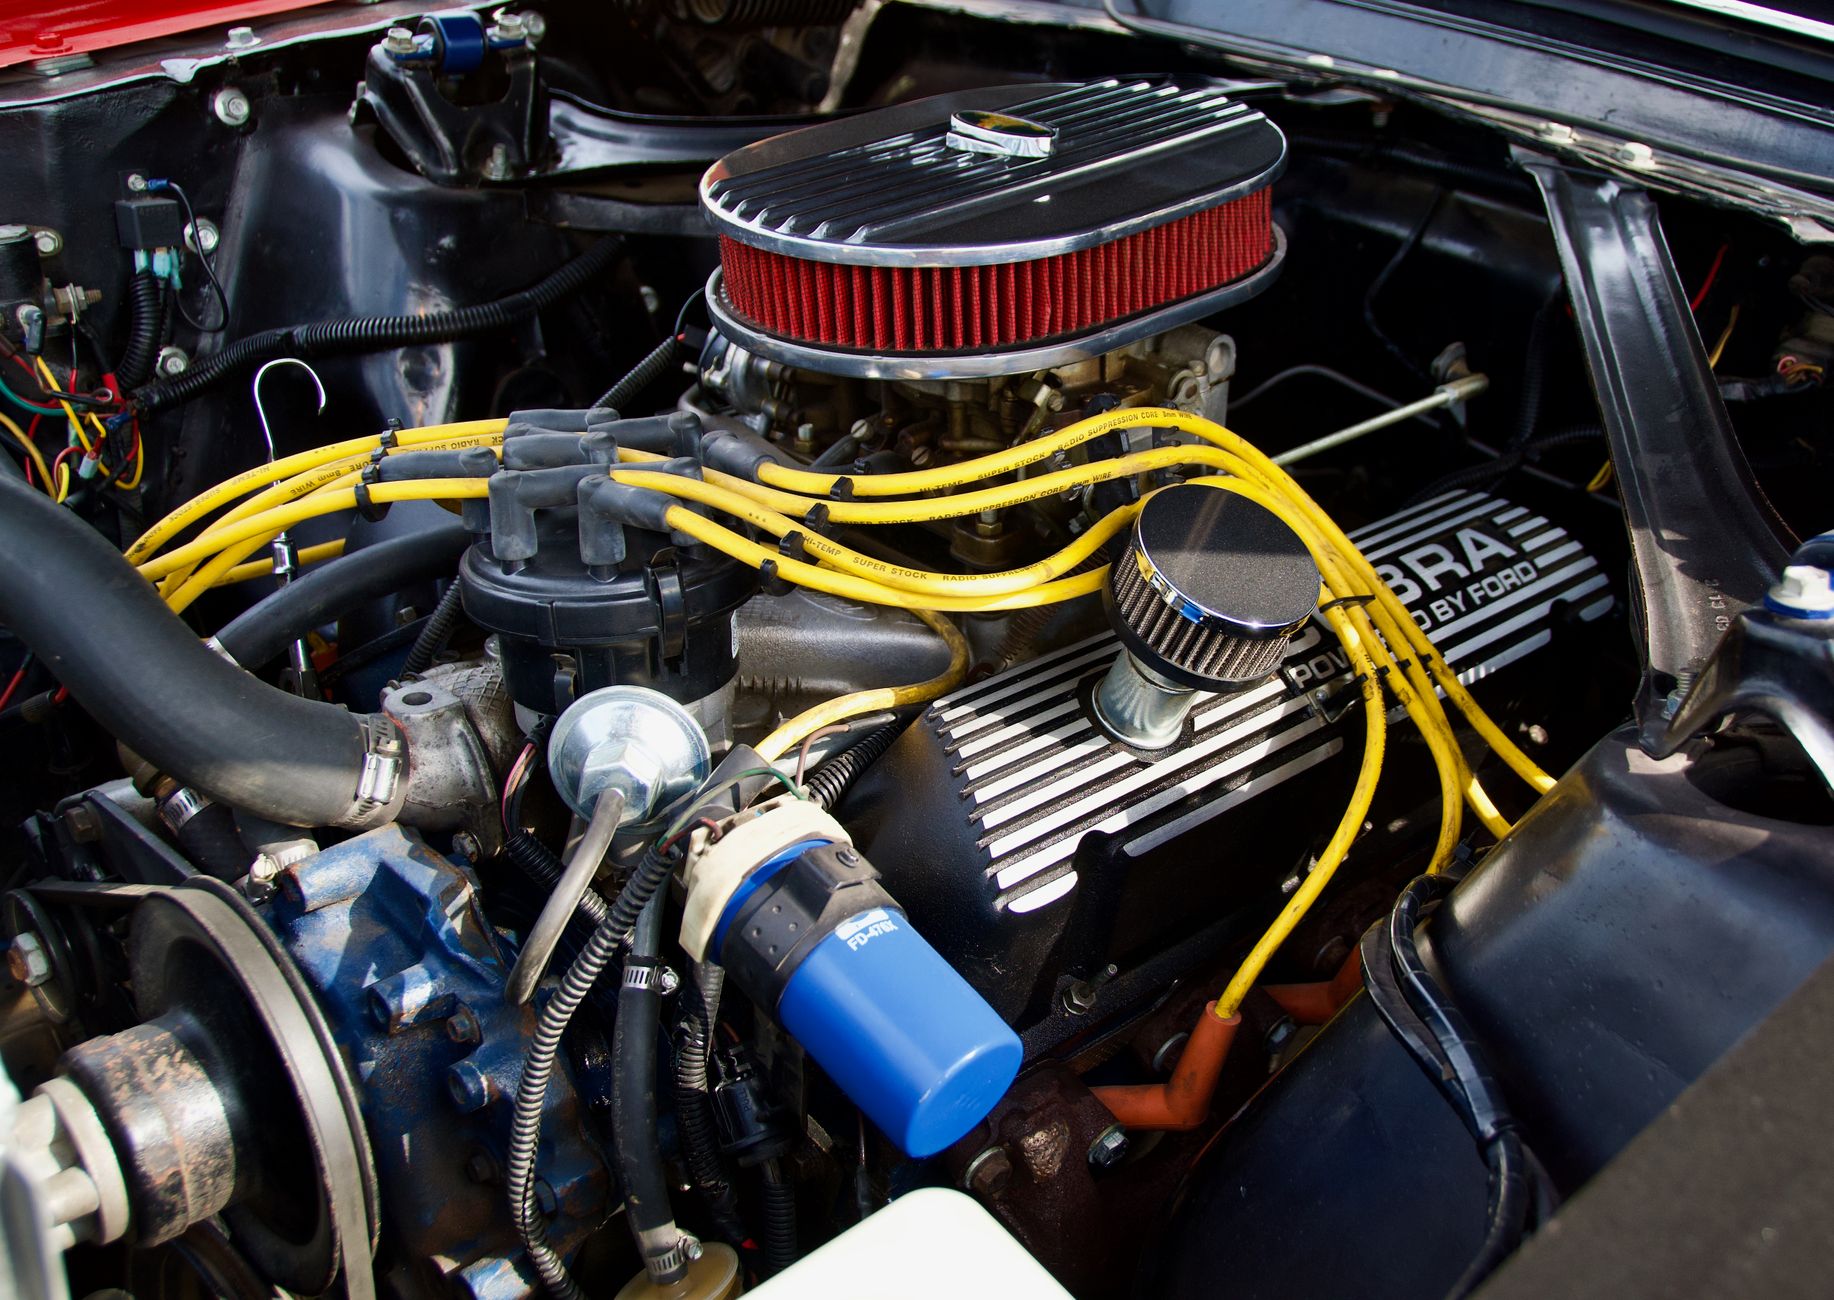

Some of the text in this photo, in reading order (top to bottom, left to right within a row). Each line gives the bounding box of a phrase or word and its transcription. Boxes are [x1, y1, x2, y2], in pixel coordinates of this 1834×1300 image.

[450, 438, 480, 450] RADIO
[977, 465, 1010, 480] SUPER
[1014, 452, 1046, 468] STOCK
[1057, 434, 1085, 450] RADIO
[1088, 413, 1139, 437] SUPPRESSION
[1140, 411, 1158, 419] CORE
[1178, 411, 1193, 420] WIRE
[289, 460, 371, 496] ORE 8mm WIRE
[969, 493, 1037, 514] SUPPRESSION
[1040, 486, 1064, 497] CORE
[1092, 471, 1112, 482] WIRE
[803, 535, 842, 557] HI-TEMP
[852, 556, 887, 572] SUPER
[891, 567, 928, 580] STOCK
[1429, 590, 1467, 623] BY
[1466, 560, 1538, 606] FORD
